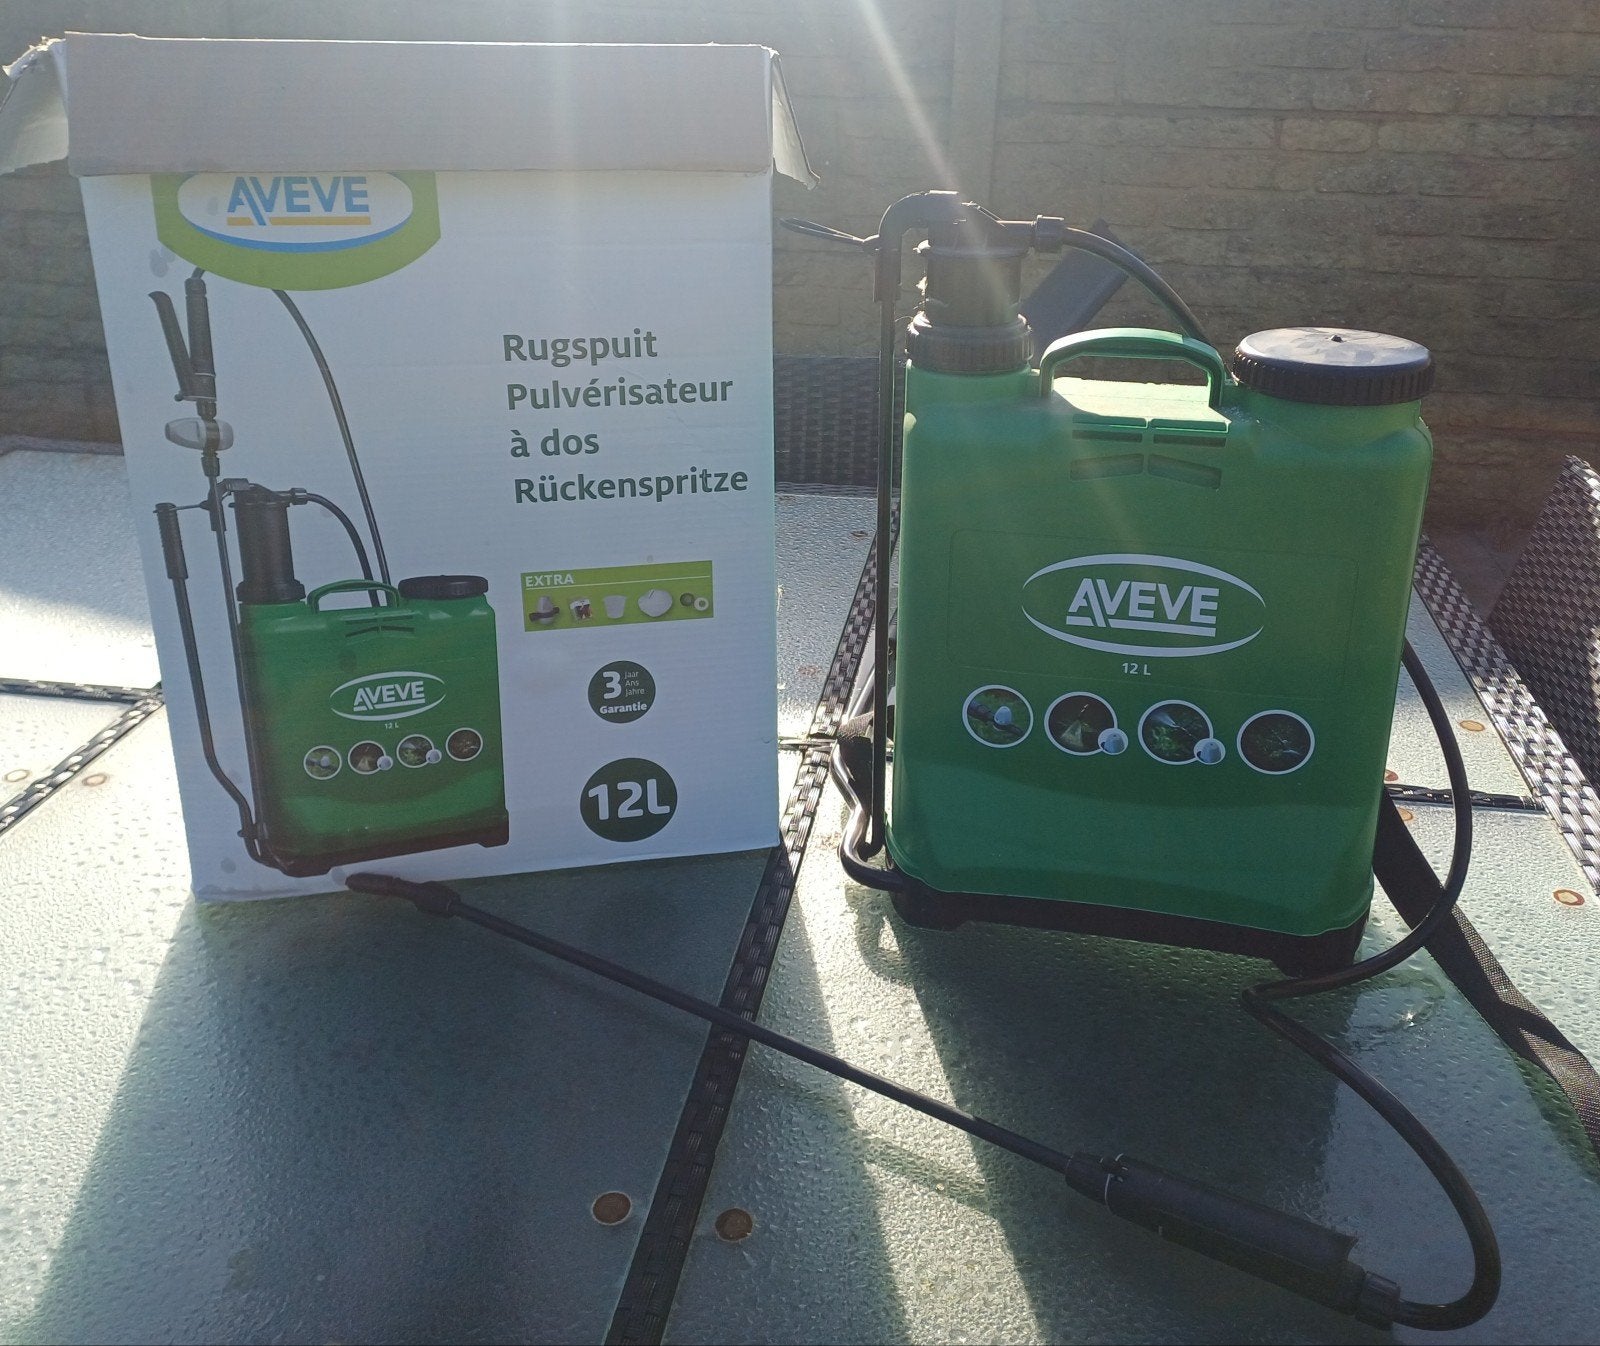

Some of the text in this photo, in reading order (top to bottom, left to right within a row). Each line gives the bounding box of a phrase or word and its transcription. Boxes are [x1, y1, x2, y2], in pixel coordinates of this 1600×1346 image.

[227, 176, 370, 225] AVEVE
[503, 328, 658, 367] Rugspuit
[507, 377, 733, 410] Pulvérisateur
[510, 429, 599, 457] à dos
[514, 466, 748, 503] Rückenspritze
[525, 574, 574, 587] EXTRA
[1066, 578, 1219, 637] AVEVE
[1122, 662, 1152, 676] 12 L
[353, 681, 425, 711] AVEVE
[602, 671, 622, 699] 3
[600, 701, 648, 714] Garantie
[588, 778, 670, 821] 12L
